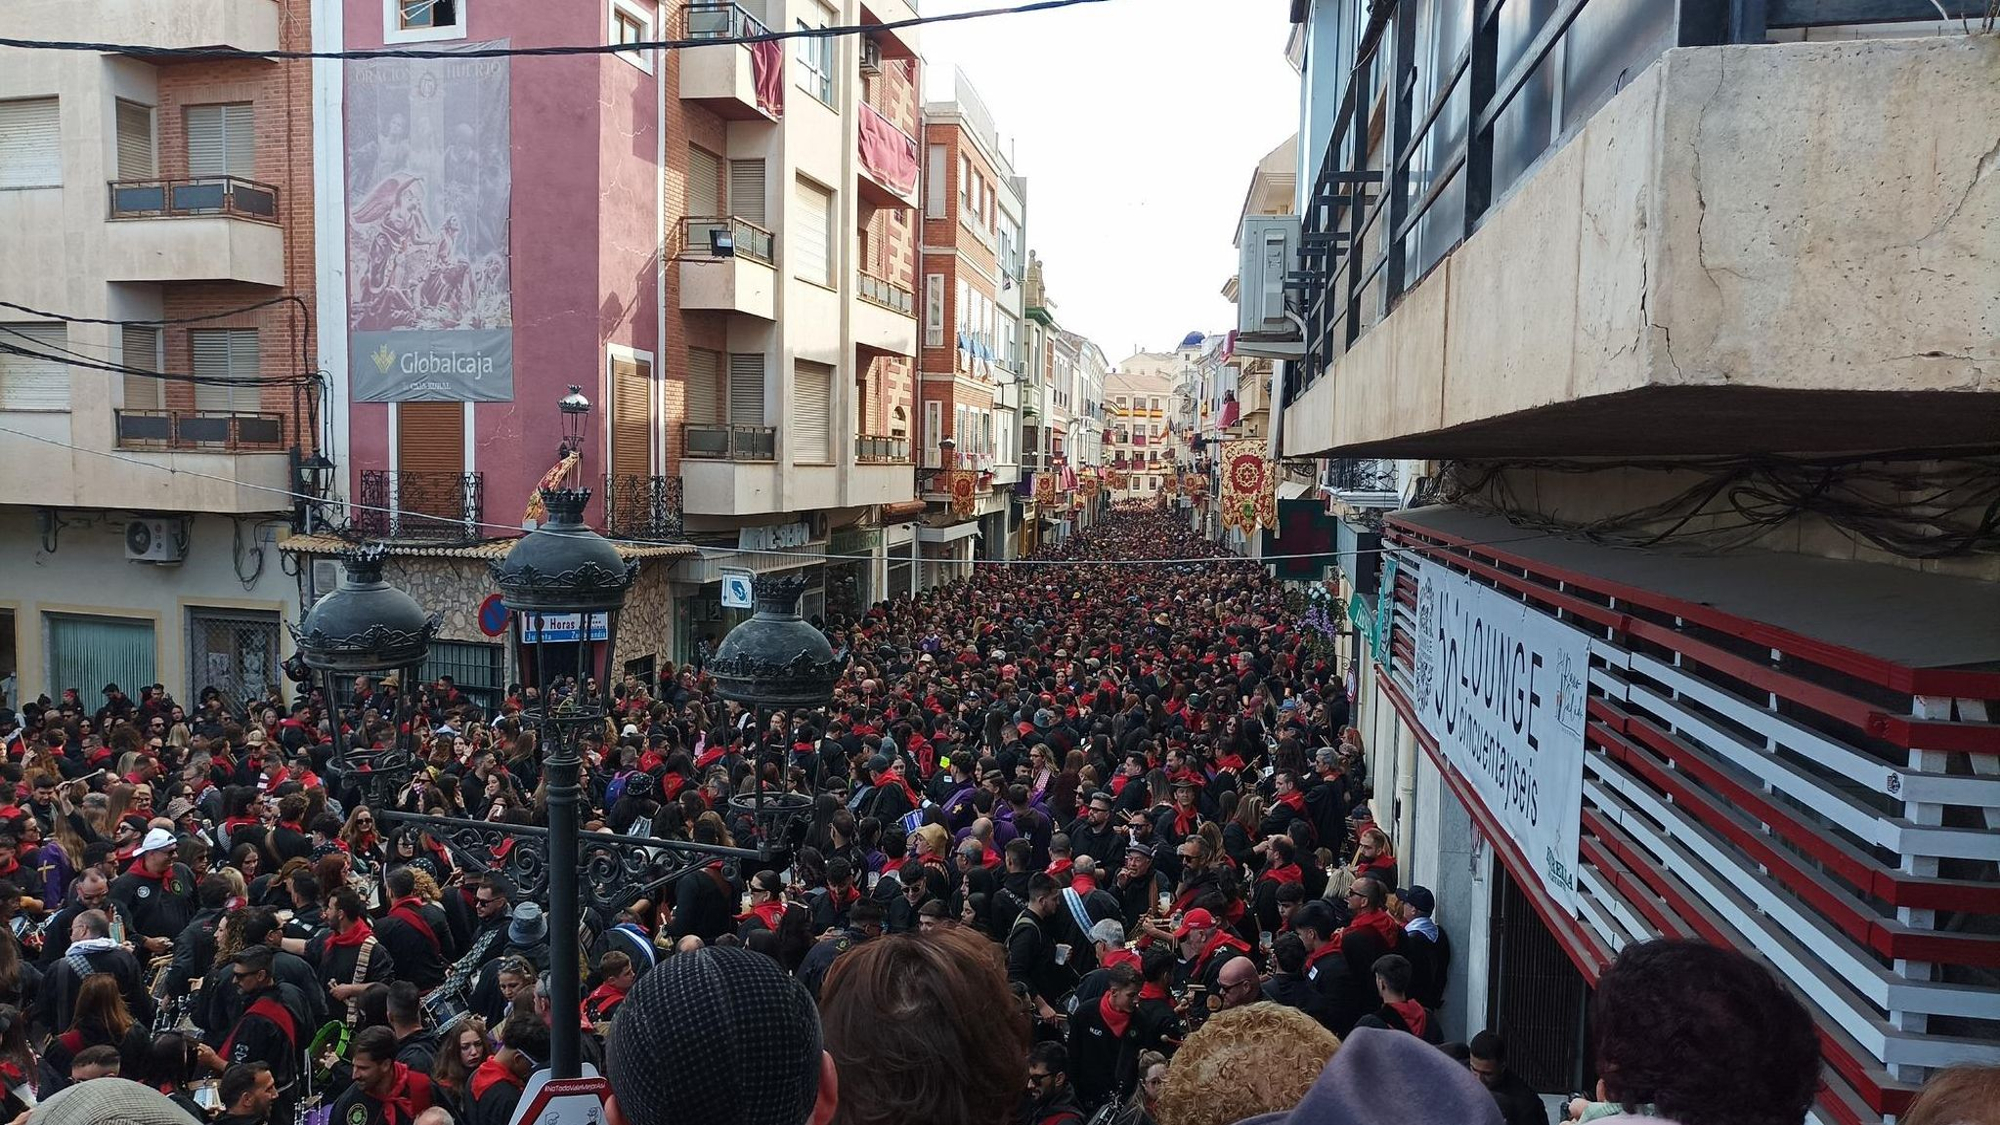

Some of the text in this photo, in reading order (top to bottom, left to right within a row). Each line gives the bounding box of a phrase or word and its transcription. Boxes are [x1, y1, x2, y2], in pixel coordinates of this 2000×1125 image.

[401, 350, 493, 380] Globalcaja
[550, 618, 575, 630] Horas
[1461, 611, 1543, 752] LOUNGE
[1458, 696, 1539, 828] cincuentayseis
